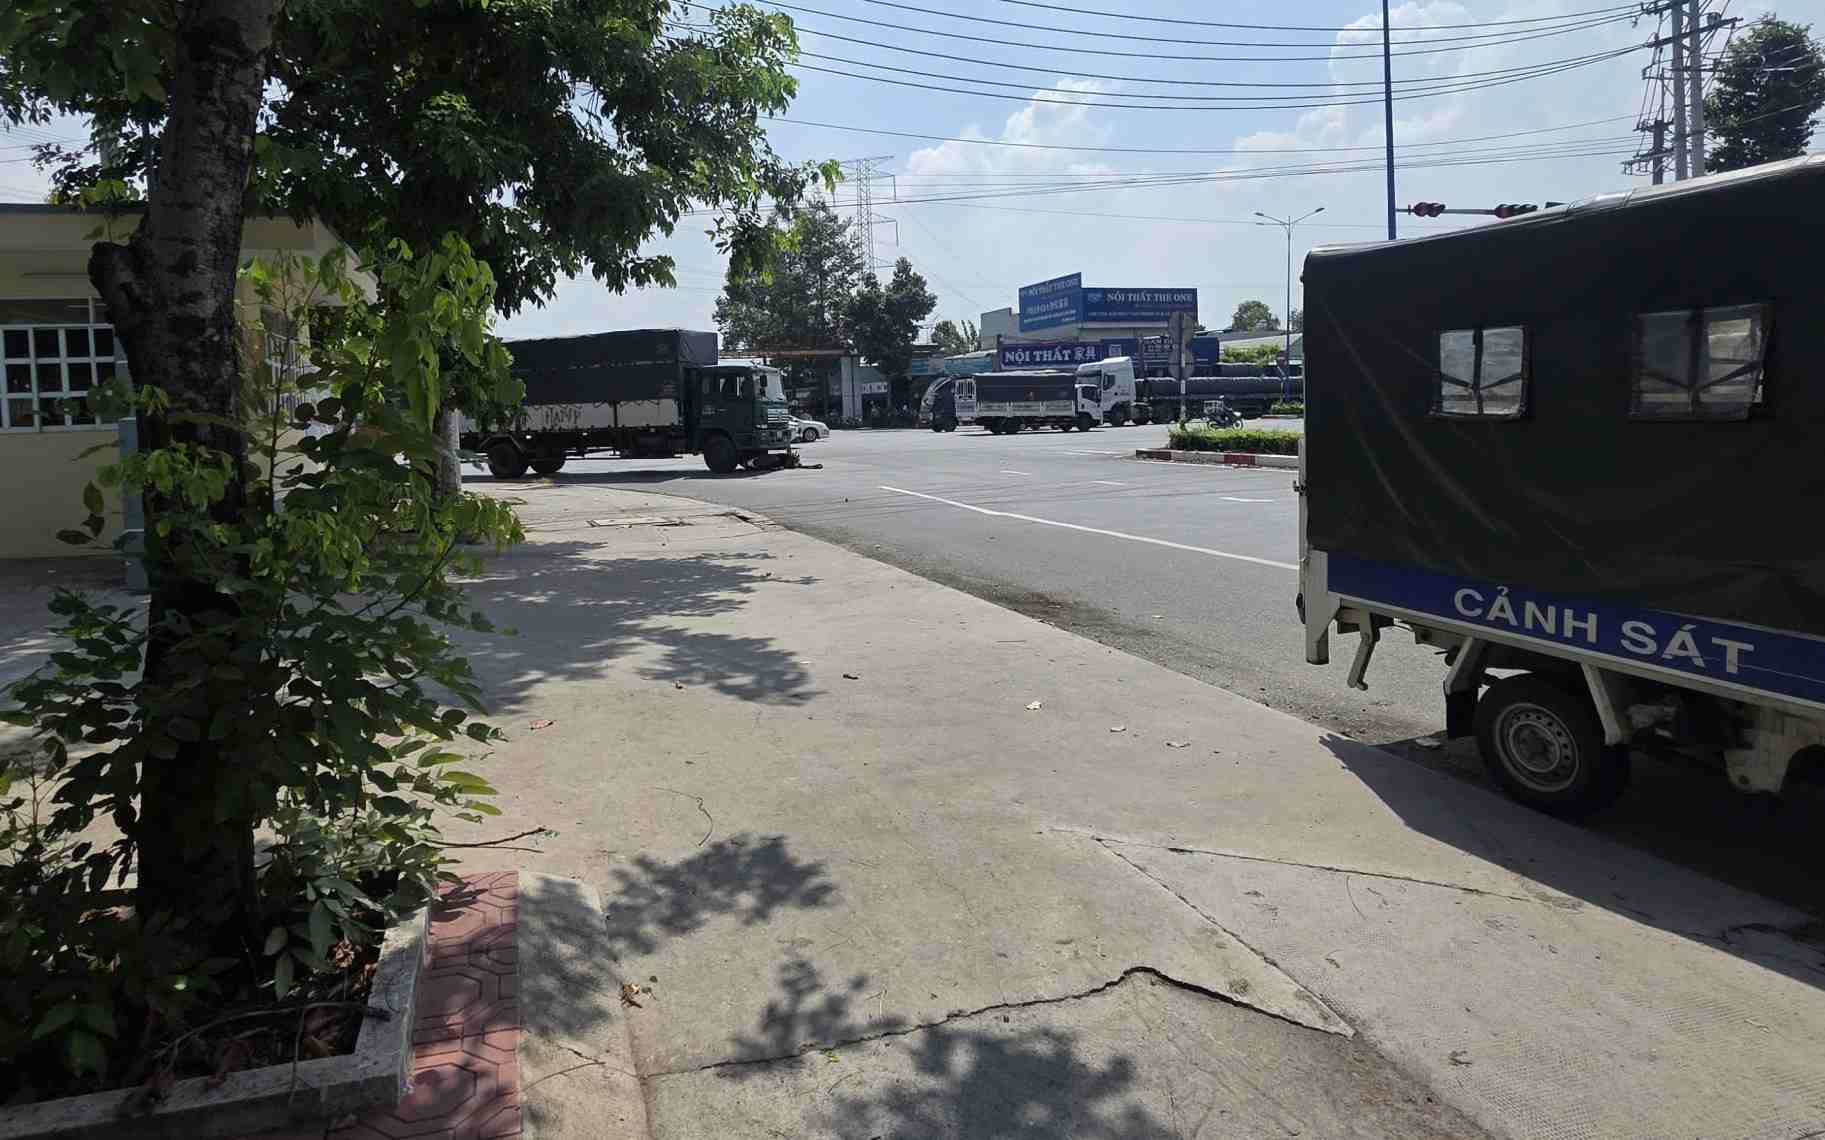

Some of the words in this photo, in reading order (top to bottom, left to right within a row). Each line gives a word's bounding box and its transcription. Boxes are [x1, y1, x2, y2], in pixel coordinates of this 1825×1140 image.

[1005, 348, 1030, 364] NỘI
[1032, 345, 1071, 361] THẤT
[1453, 584, 1599, 644] CẢNH
[1620, 622, 1755, 675] SÁT
